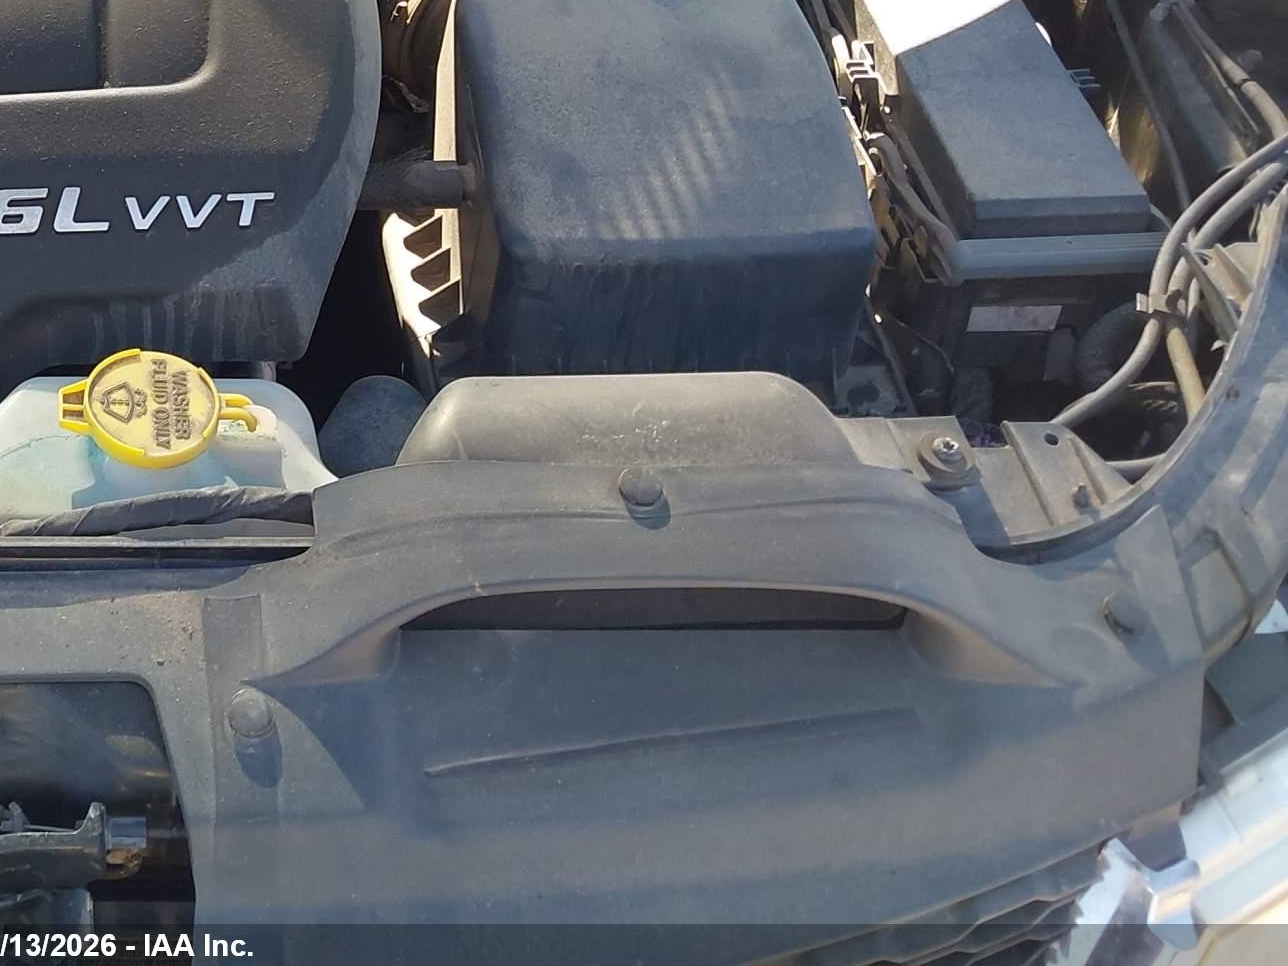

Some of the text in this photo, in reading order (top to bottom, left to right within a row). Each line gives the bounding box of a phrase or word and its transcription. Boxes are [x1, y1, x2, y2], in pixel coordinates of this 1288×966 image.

[123, 191, 275, 231] VVT
[150, 358, 171, 450] FLUID ONLY
[171, 370, 191, 440] WASHER
